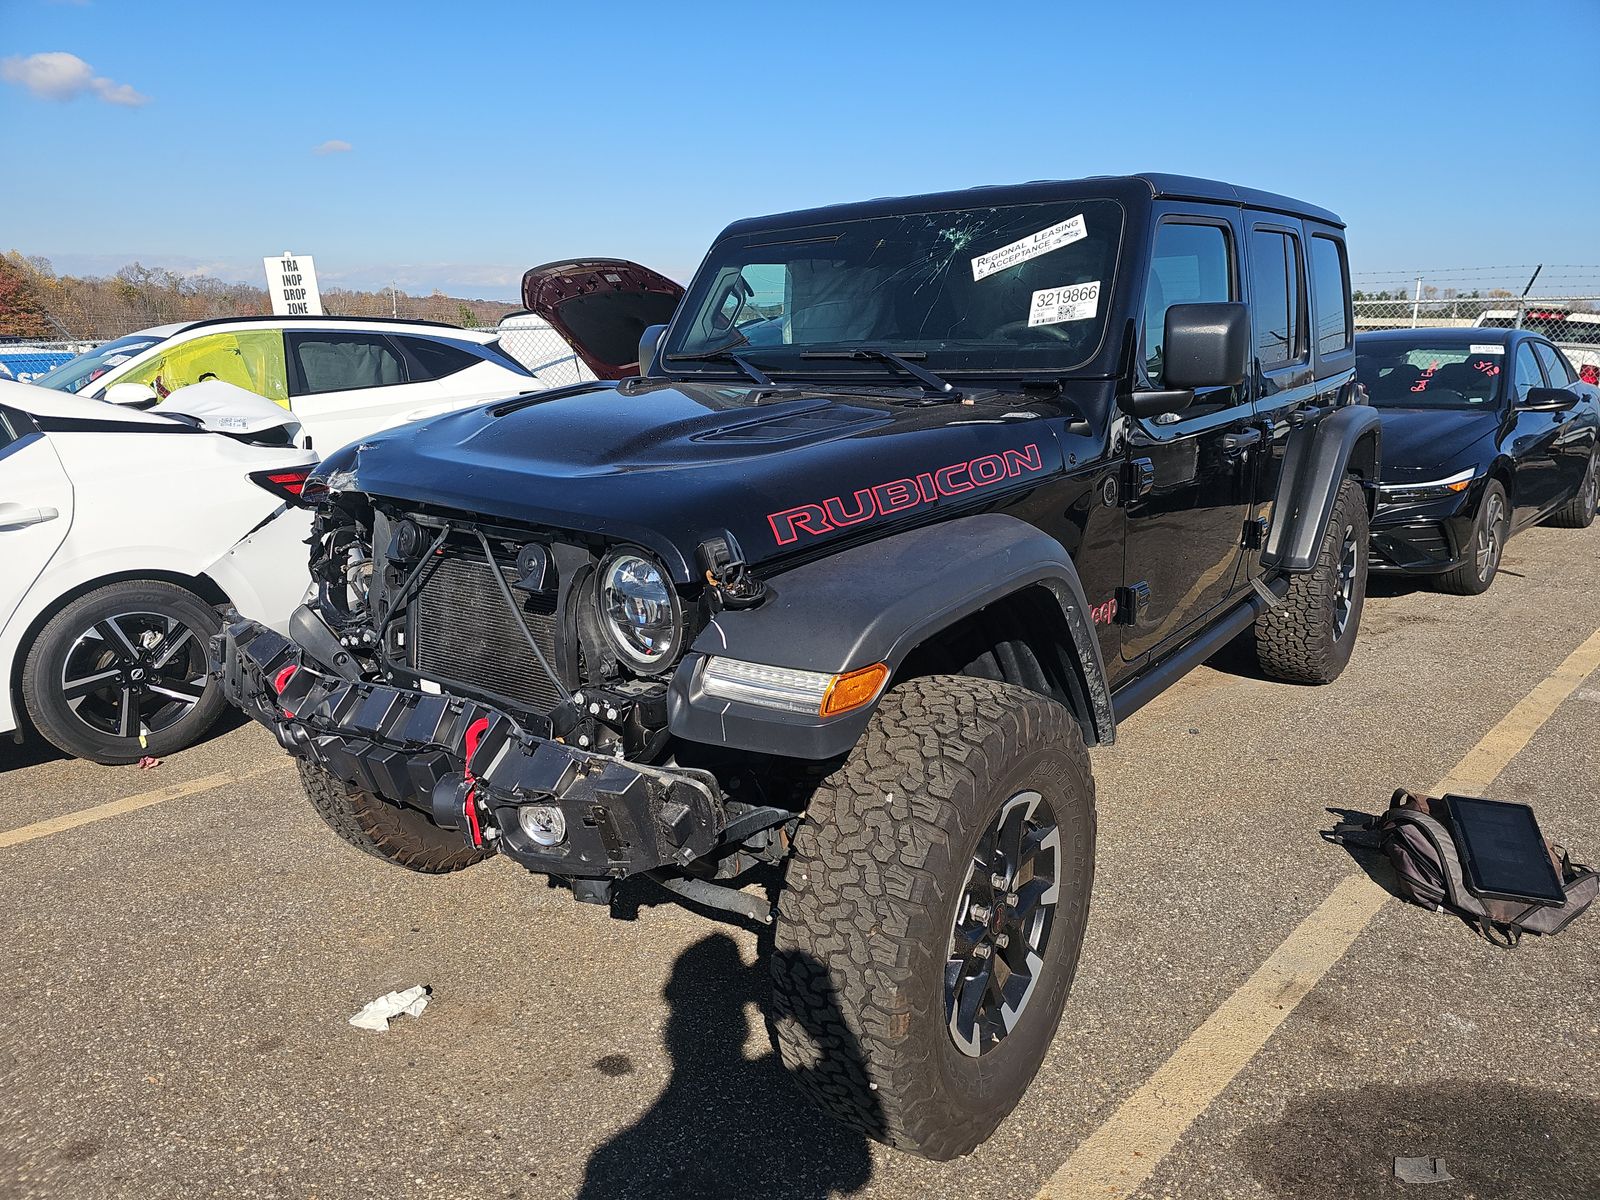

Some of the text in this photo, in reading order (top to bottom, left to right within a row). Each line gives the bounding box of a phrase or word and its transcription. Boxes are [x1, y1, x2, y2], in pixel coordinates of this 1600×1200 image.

[977, 243, 1027, 267] REGIONAL
[1034, 220, 1079, 243] LEASING
[988, 240, 1051, 270] ACCEPTANCE
[281, 260, 299, 272] TRA
[282, 274, 303, 286] INOP
[283, 288, 307, 301] DROP
[1037, 286, 1097, 307] 3219866
[287, 303, 308, 314] ZONE
[767, 444, 1043, 546] RUBICON
